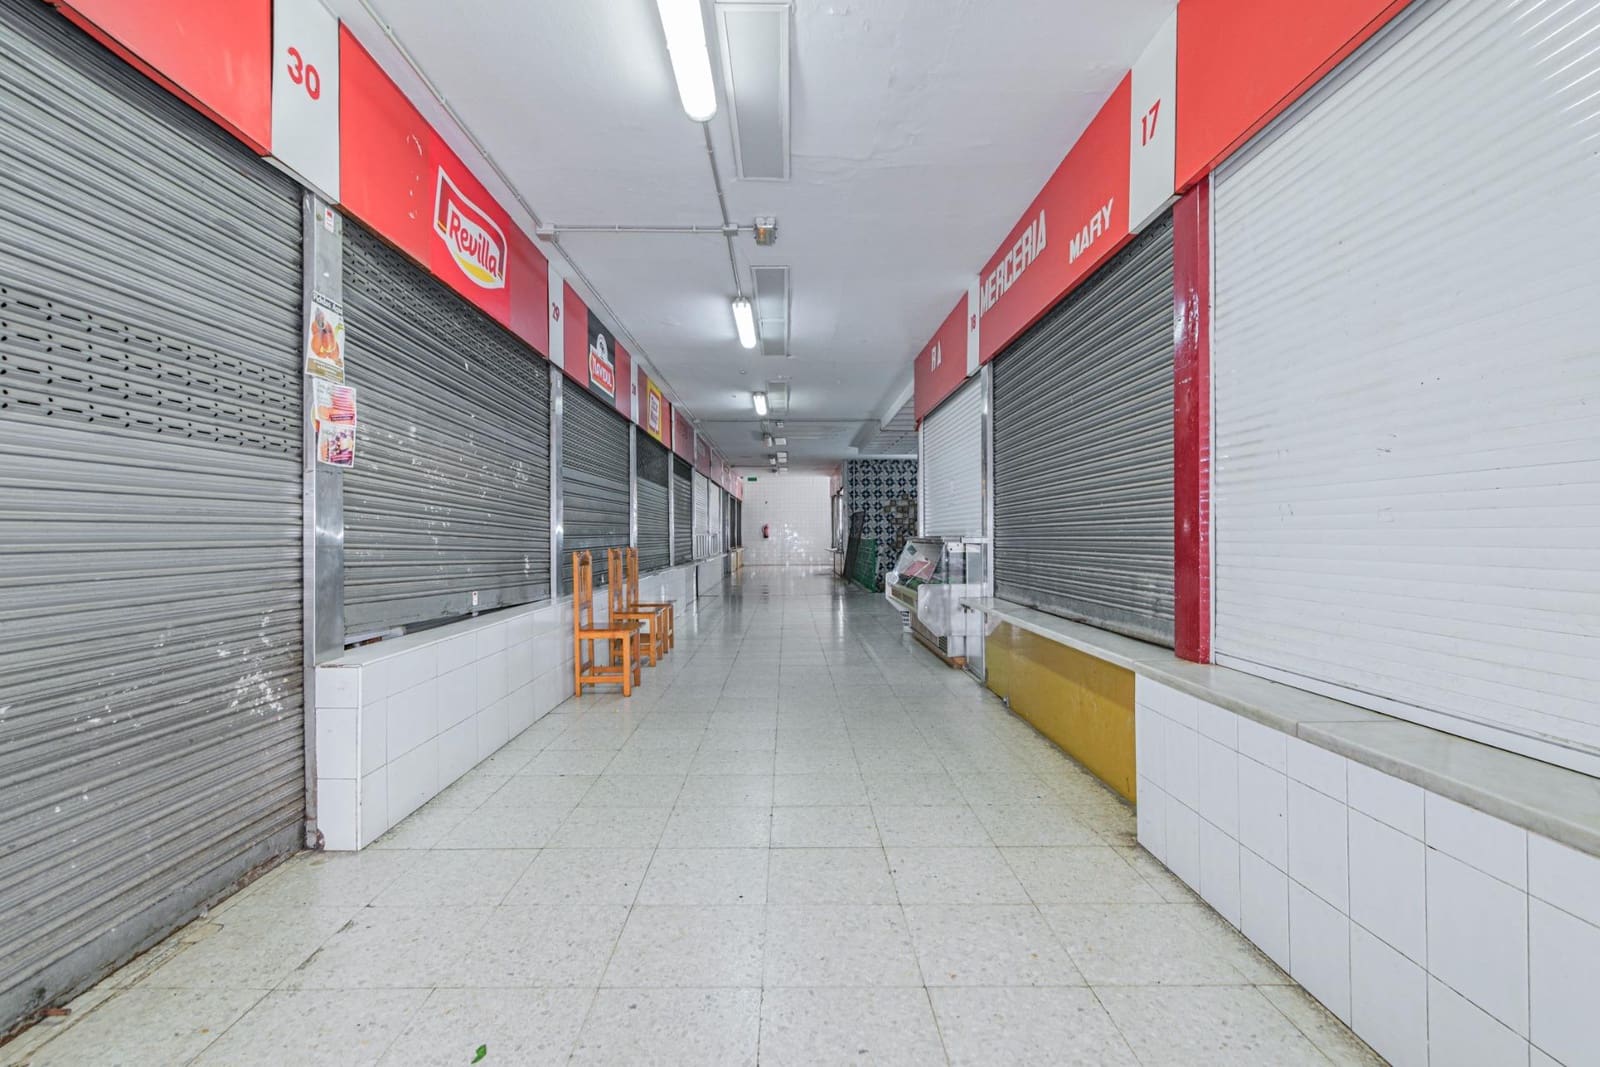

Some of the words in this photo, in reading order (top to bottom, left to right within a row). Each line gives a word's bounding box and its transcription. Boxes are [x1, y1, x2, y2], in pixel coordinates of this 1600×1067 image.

[287, 47, 320, 100] 30
[1141, 99, 1161, 146] 17
[448, 214, 498, 277] Revilla
[1069, 197, 1114, 265] MARY
[980, 209, 1047, 318] MERCERIA
[552, 301, 560, 323] 29
